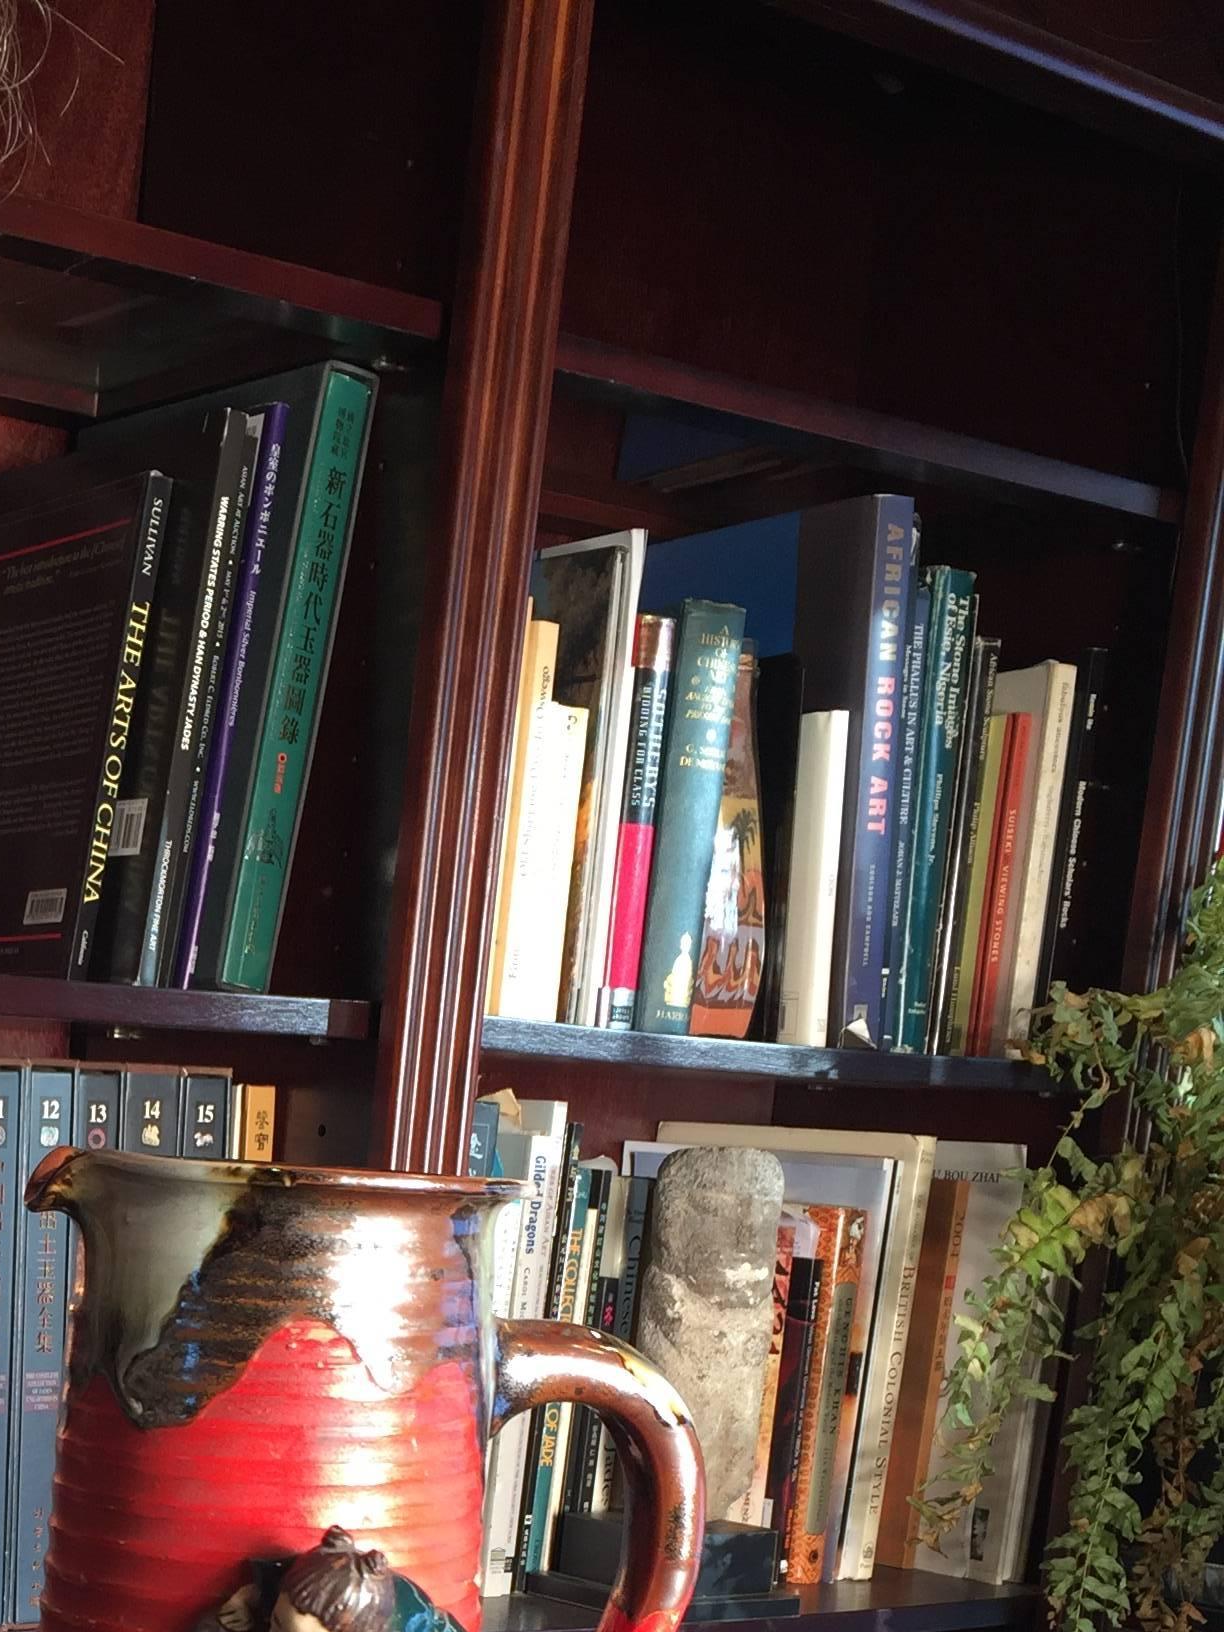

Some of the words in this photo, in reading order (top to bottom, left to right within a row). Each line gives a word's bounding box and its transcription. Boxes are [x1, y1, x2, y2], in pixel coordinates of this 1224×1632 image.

[140, 496, 163, 576] SULLIVAN
[211, 495, 230, 548] WARRING
[228, 518, 241, 555] AUCTION
[206, 547, 221, 587] STATES
[199, 587, 215, 629] PERIOD
[242, 589, 256, 630] Imperial
[878, 522, 905, 662] AFRICAN
[946, 591, 959, 610] of
[954, 594, 971, 631] The
[122, 599, 150, 667] THE
[193, 638, 207, 664] HAN
[197, 629, 208, 639] &
[237, 631, 250, 659] Silver
[912, 622, 924, 649] THE
[940, 614, 957, 657] Esie,
[907, 651, 922, 708] PHALLUS
[947, 633, 967, 685] Stone
[985, 652, 998, 687] African
[107, 668, 138, 751] ARTS
[185, 665, 202, 716] DYNASTY
[637, 685, 653, 737] BIDDING
[931, 659, 952, 725] Nigeria
[179, 715, 194, 751] JADES
[871, 675, 896, 763] ROCK
[906, 711, 917, 725] IN
[941, 685, 959, 750] Images
[976, 716, 990, 761] Sculpture
[635, 741, 645, 765] FOR
[902, 754, 913, 766] &
[903, 727, 916, 753] ART
[100, 753, 124, 798] OF
[630, 767, 643, 807] CLASS
[897, 767, 913, 825] CULTURE
[866, 775, 889, 835] ART
[1072, 779, 1087, 816] Modern
[1003, 808, 1017, 854] SUISEKI
[1067, 817, 1082, 855] Chinese
[81, 801, 116, 906] CHINA
[995, 864, 1010, 915] VIEWING
[150, 912, 161, 933] FINE
[1058, 899, 1071, 929] Rocks
[147, 932, 158, 953] ART
[989, 918, 1003, 962] STONES
[42, 1100, 60, 1119] 12
[89, 1103, 107, 1123] 13
[143, 1100, 160, 1120] 14
[197, 1104, 214, 1123] 15
[521, 1199, 541, 1255] Dragons
[567, 1226, 584, 1256] THE
[618, 1234, 644, 1335] Chinese
[893, 1265, 915, 1342] BRITISH
[836, 1297, 853, 1378] GENGHIS
[543, 1406, 560, 1433] OF
[828, 1387, 841, 1436] KHAN
[877, 1350, 903, 1449] COLONIAL
[539, 1433, 557, 1468] JADE
[868, 1456, 887, 1515] STYLE
